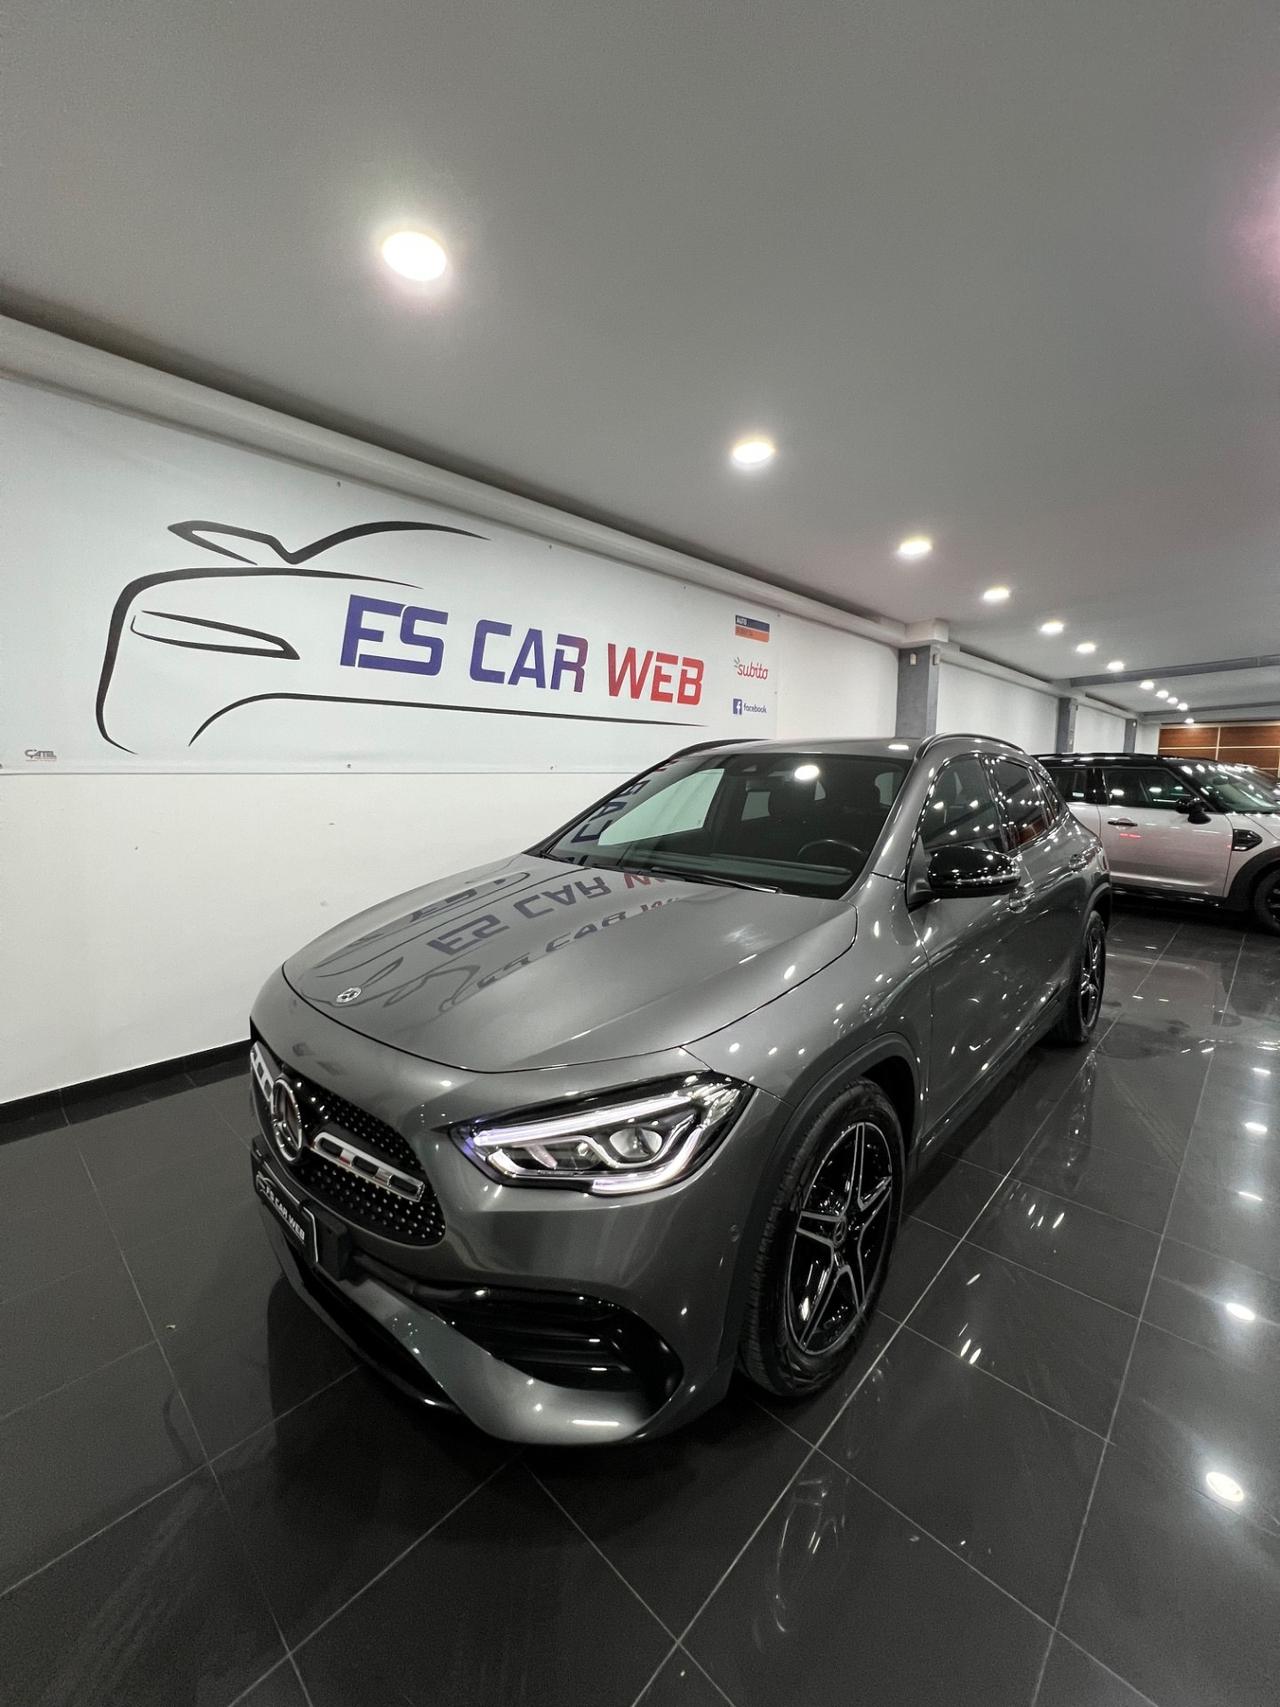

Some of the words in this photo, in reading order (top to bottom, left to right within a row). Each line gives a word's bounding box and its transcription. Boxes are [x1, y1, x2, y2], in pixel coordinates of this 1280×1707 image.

[340, 594, 449, 677] ES
[469, 619, 589, 693] CAR
[607, 643, 704, 706] WEB
[737, 662, 769, 680] subito
[743, 703, 767, 714] facebook
[274, 1197, 288, 1219] CAR
[288, 1214, 305, 1241] WEB
